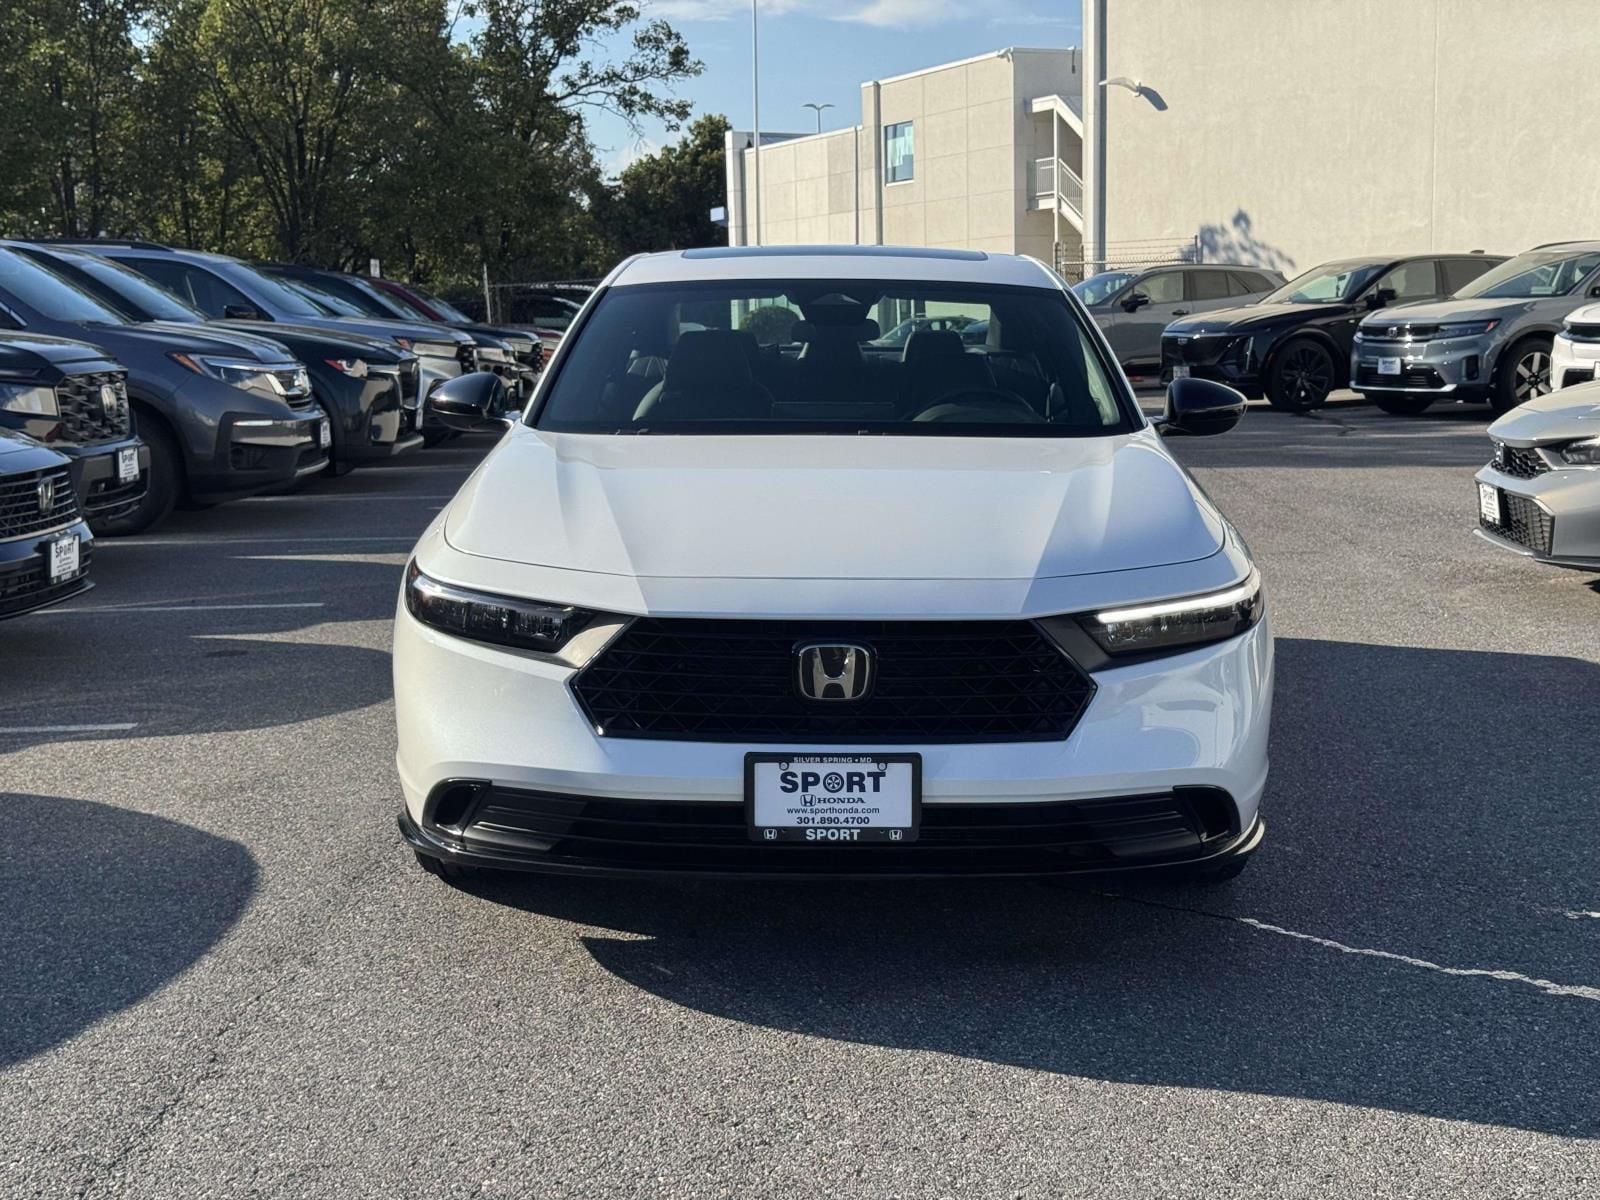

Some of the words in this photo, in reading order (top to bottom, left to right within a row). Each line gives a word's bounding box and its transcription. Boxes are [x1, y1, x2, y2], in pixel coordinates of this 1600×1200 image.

[55, 543, 74, 558] SPORT
[794, 756, 820, 764] SILVER
[823, 756, 853, 764] SPRING
[780, 771, 886, 793] SPORT
[816, 796, 866, 804] HONDA
[786, 806, 880, 815] www.sporthonda.com
[796, 816, 870, 825] 301.890.4700
[805, 828, 861, 840] SPORT
